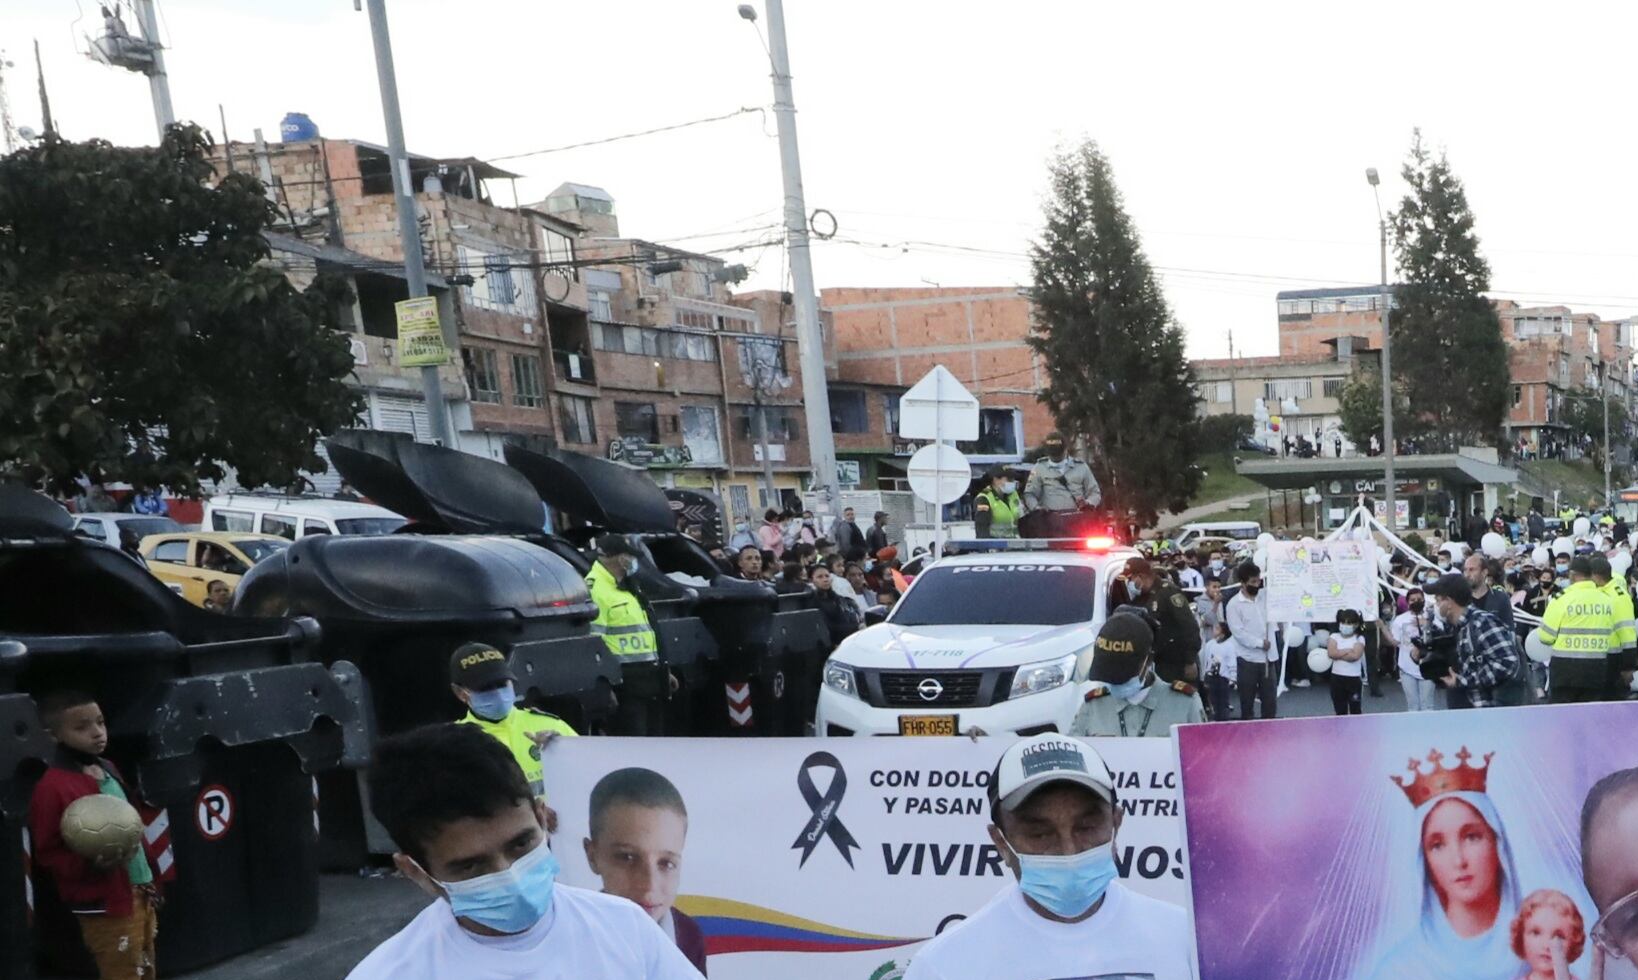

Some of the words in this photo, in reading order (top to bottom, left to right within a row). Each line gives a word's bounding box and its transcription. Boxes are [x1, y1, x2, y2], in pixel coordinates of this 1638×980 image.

[1355, 481, 1375, 492] CAI
[952, 565, 1066, 574] POLICIA
[1567, 604, 1612, 616] POLICIA
[1096, 636, 1134, 652] OLICIA
[870, 770, 920, 788] CON
[927, 770, 991, 788] DOLO
[883, 797, 899, 814] Y
[905, 797, 983, 815] PASAN
